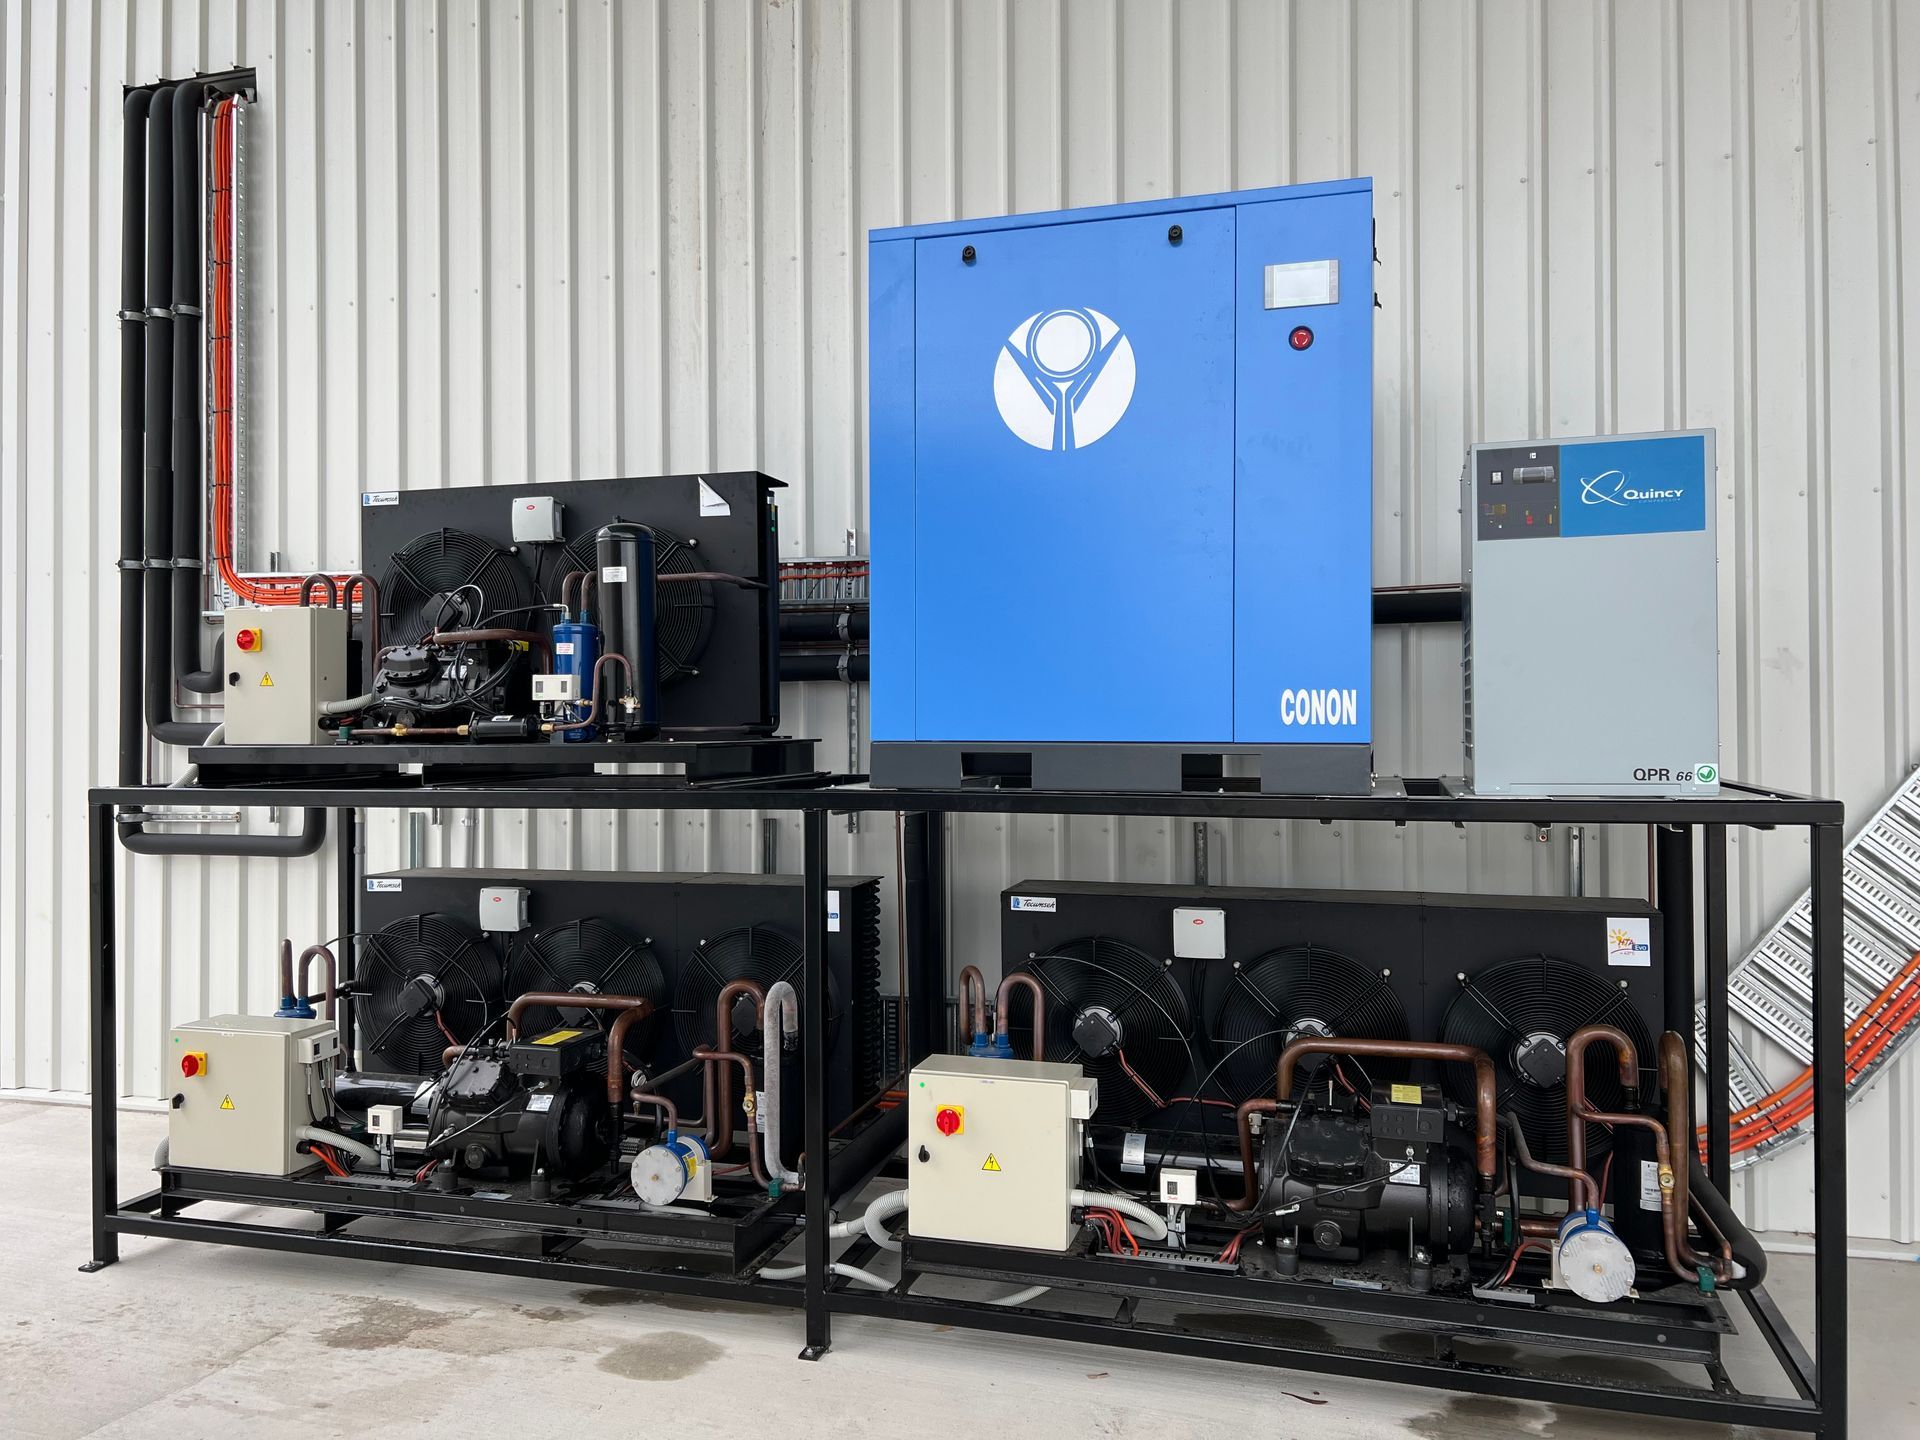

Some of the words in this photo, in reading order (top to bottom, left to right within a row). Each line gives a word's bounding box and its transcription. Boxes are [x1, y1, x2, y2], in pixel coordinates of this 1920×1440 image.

[1281, 688, 1357, 726] CONON
[1633, 768, 1670, 781] QPR
[1676, 771, 1693, 782] 66
[1023, 899, 1056, 909] Tecumseh
